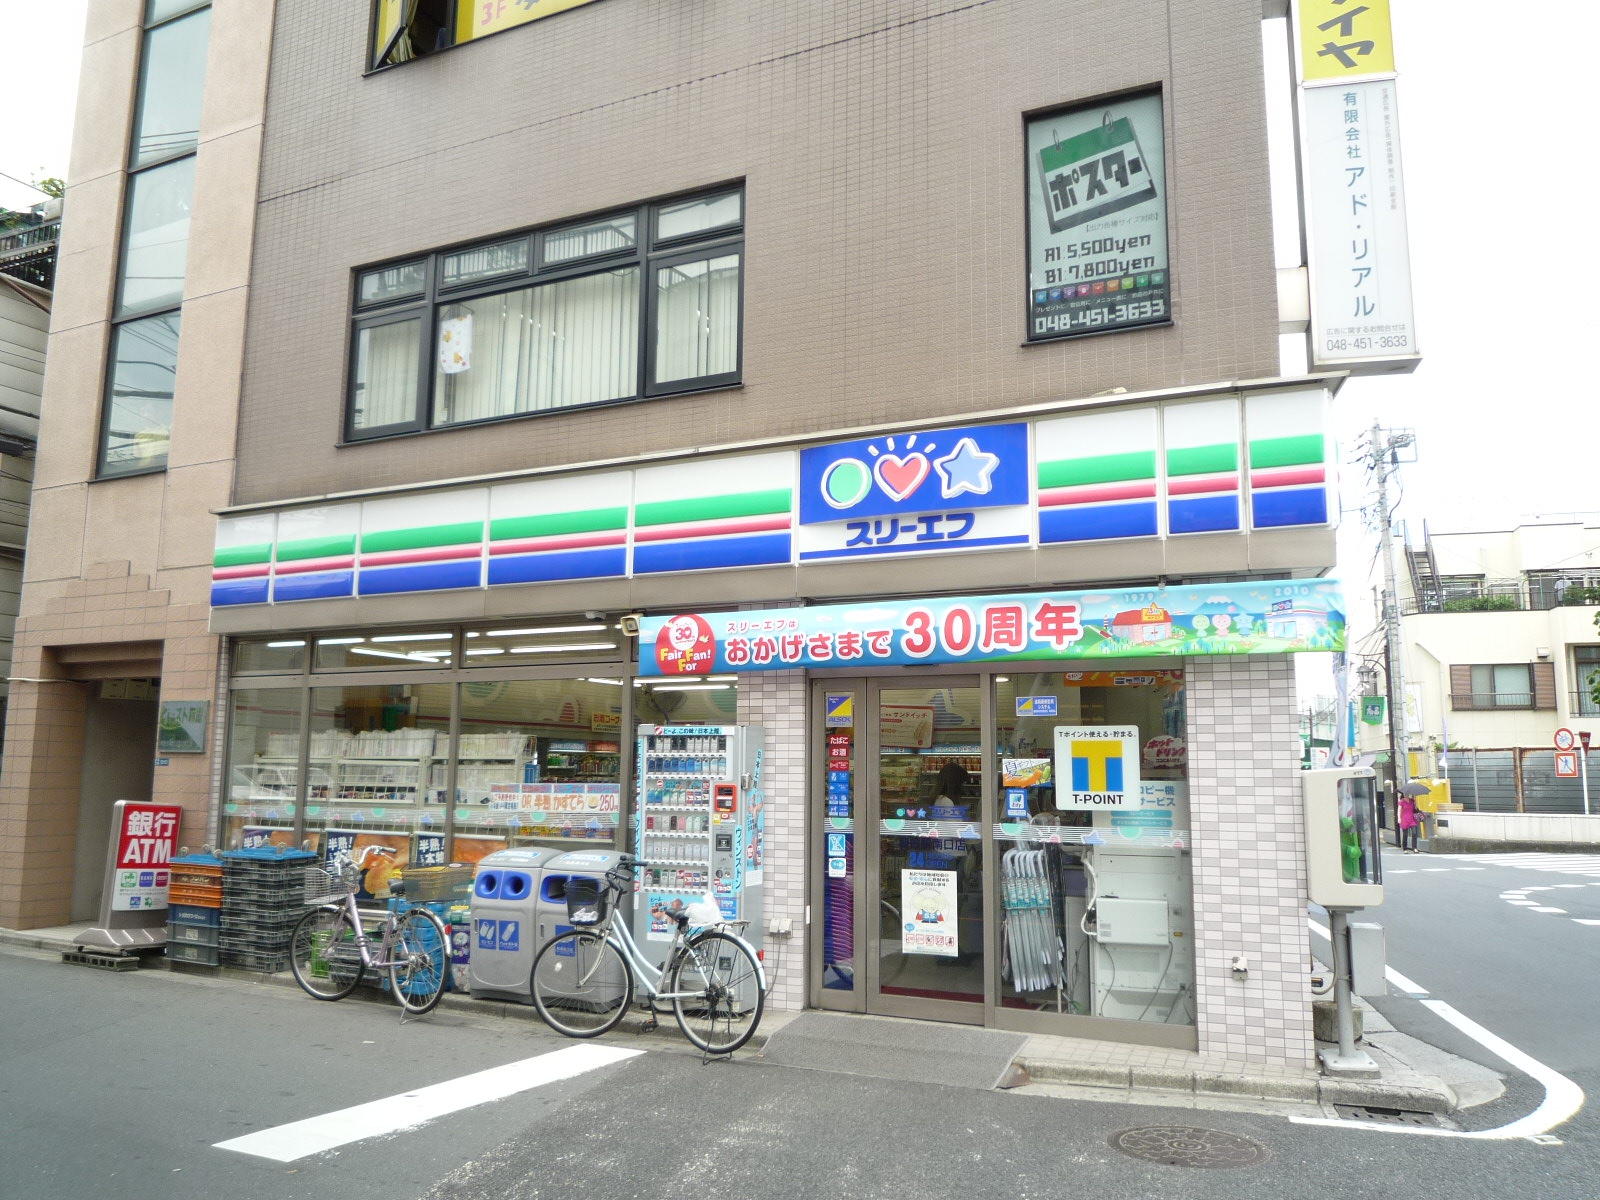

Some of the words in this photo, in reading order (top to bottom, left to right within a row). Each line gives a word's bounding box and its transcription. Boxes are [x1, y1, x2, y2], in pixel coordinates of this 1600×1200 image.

[1316, 0, 1375, 69] イヤ
[1049, 150, 1143, 212] ポスター
[1035, 299, 1165, 334] 048-451-3633
[1326, 335, 1408, 351] 048-451-3633
[846, 512, 976, 548] スリーエフ
[1124, 592, 1155, 603] 1979
[1274, 587, 1309, 597] 2010
[727, 618, 797, 632] スリーエフは
[660, 648, 683, 662] Fair
[685, 648, 711, 662] Fan!
[677, 658, 698, 672] For
[830, 736, 849, 745] たばこ
[1072, 794, 1124, 805] T-POINT
[127, 810, 176, 837] 銀行
[123, 838, 171, 864] ATM
